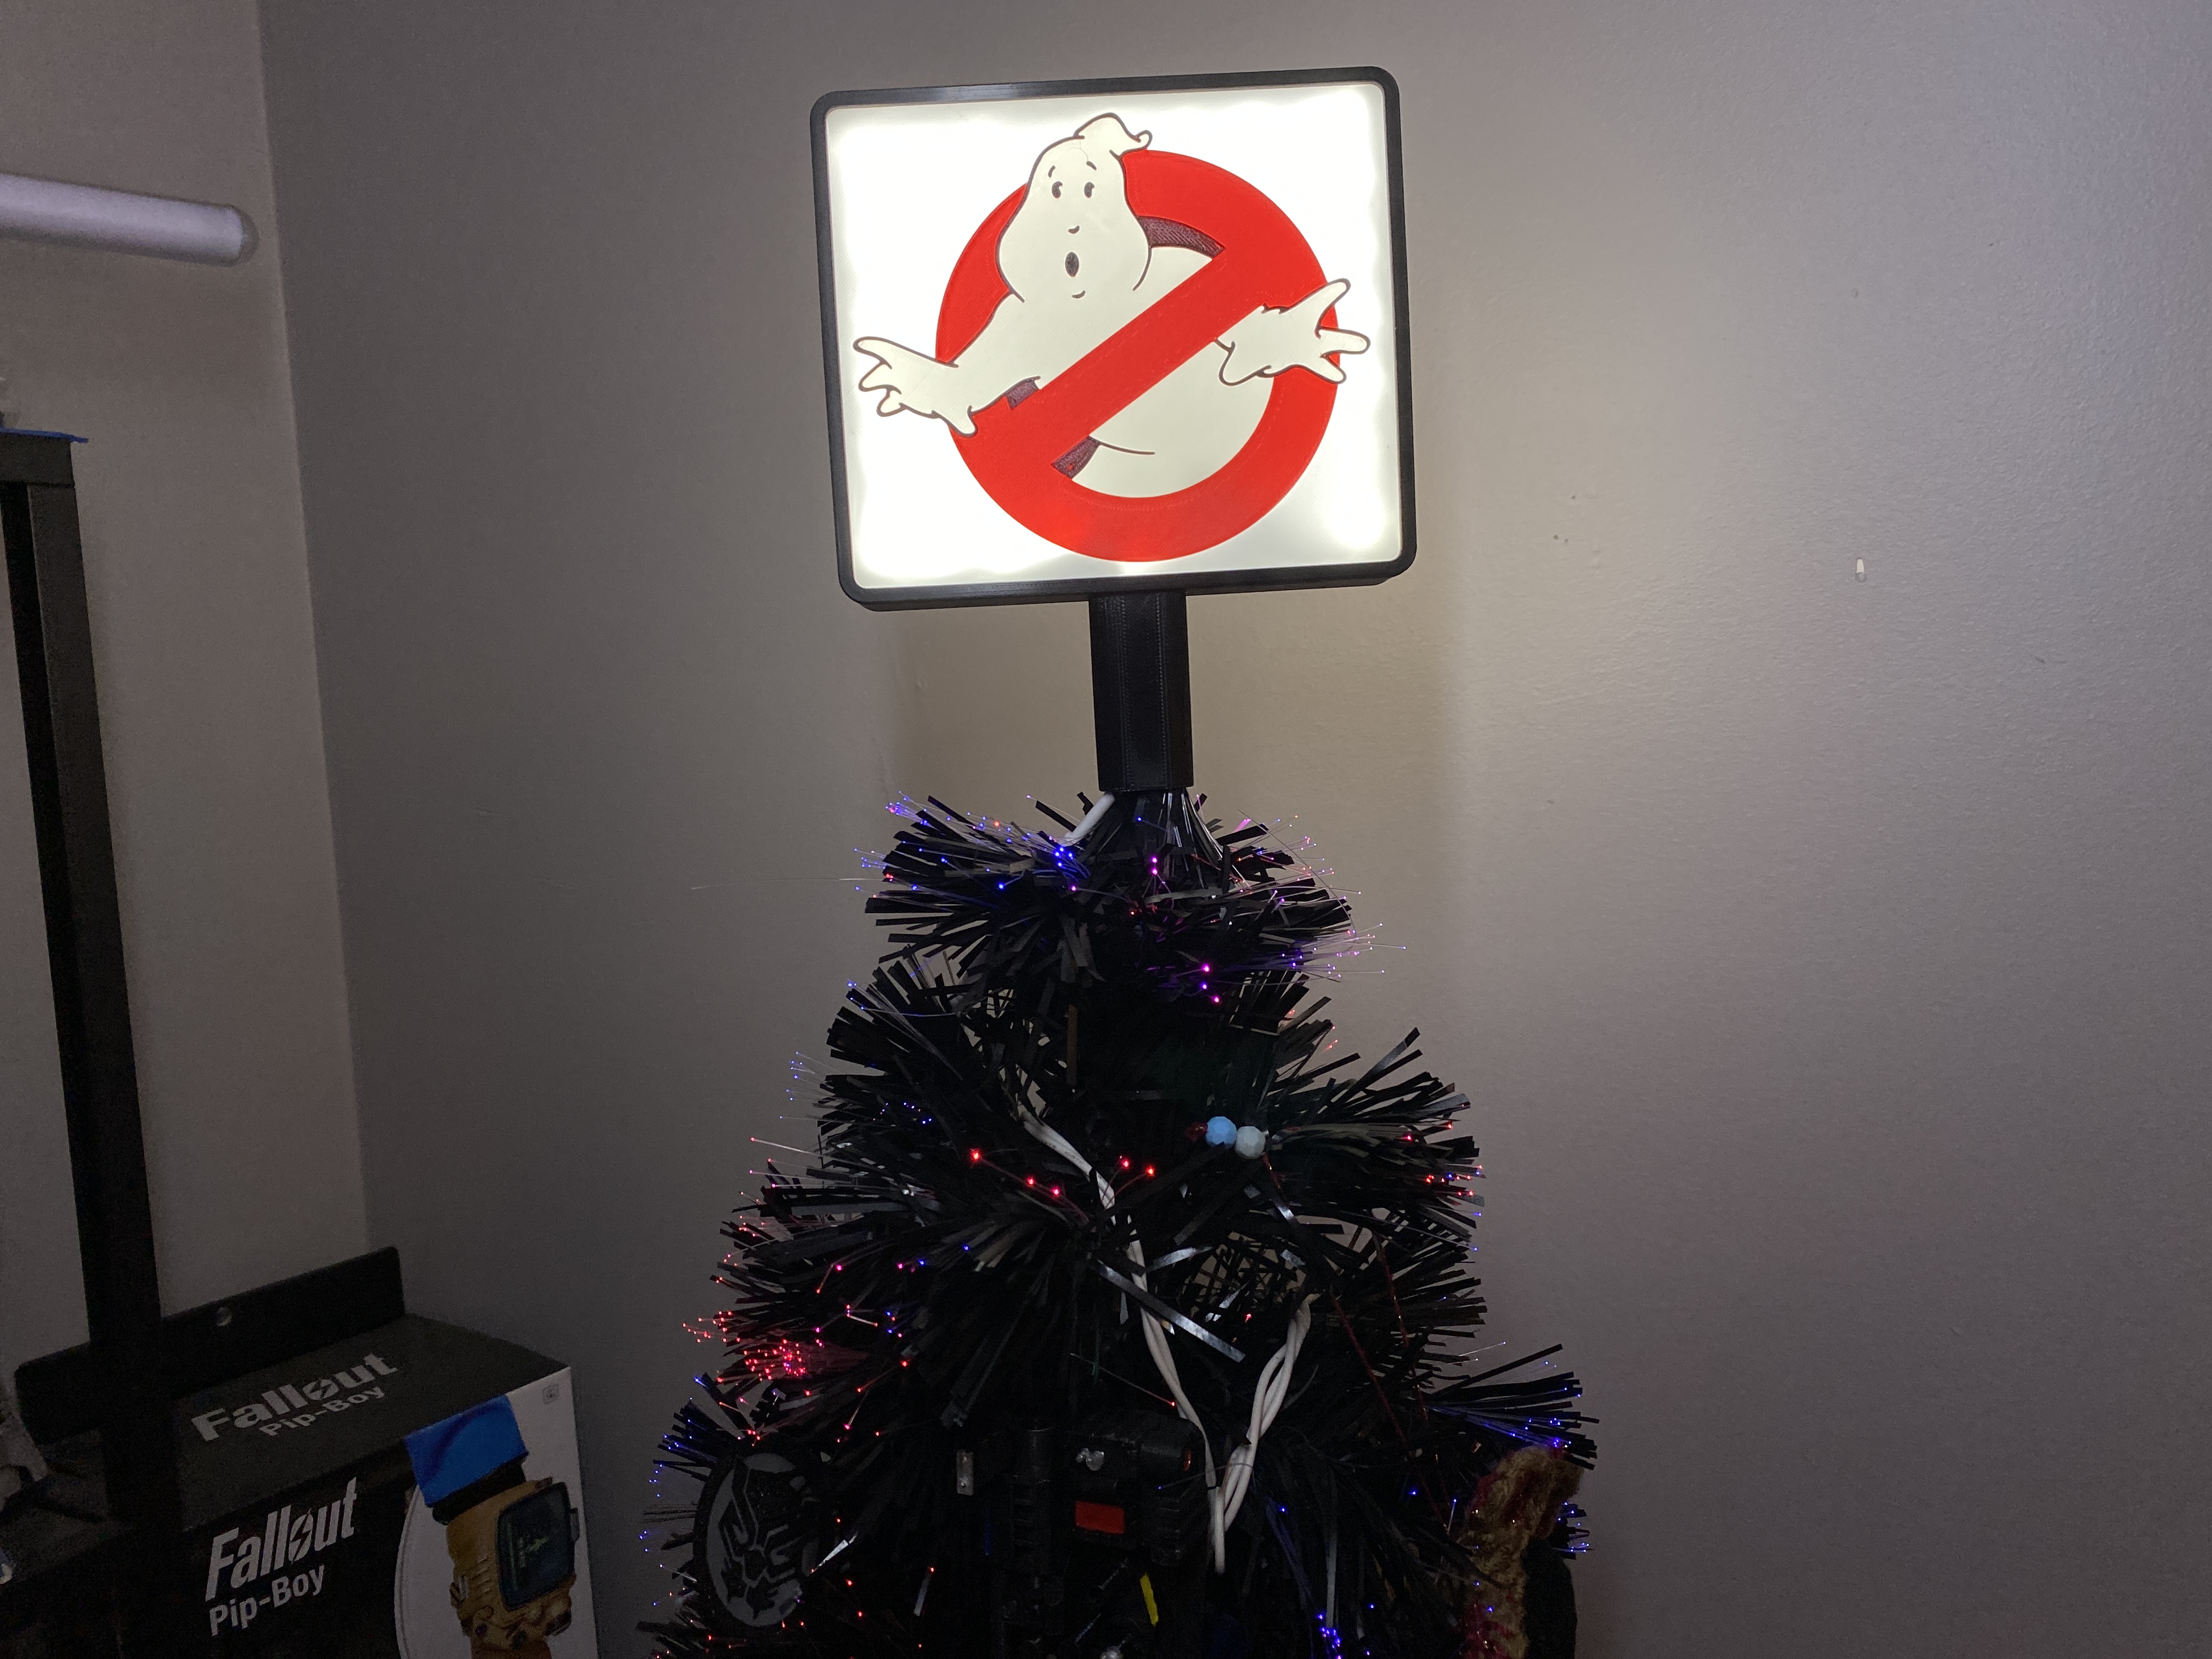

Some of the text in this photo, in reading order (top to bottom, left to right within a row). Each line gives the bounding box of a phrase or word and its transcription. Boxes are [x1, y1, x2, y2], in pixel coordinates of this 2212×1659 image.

[191, 1353, 398, 1441] Fallout
[259, 1387, 385, 1436] Pip-Boy
[205, 1476, 357, 1602] Fallout
[209, 1564, 325, 1637] Pip-Boy
